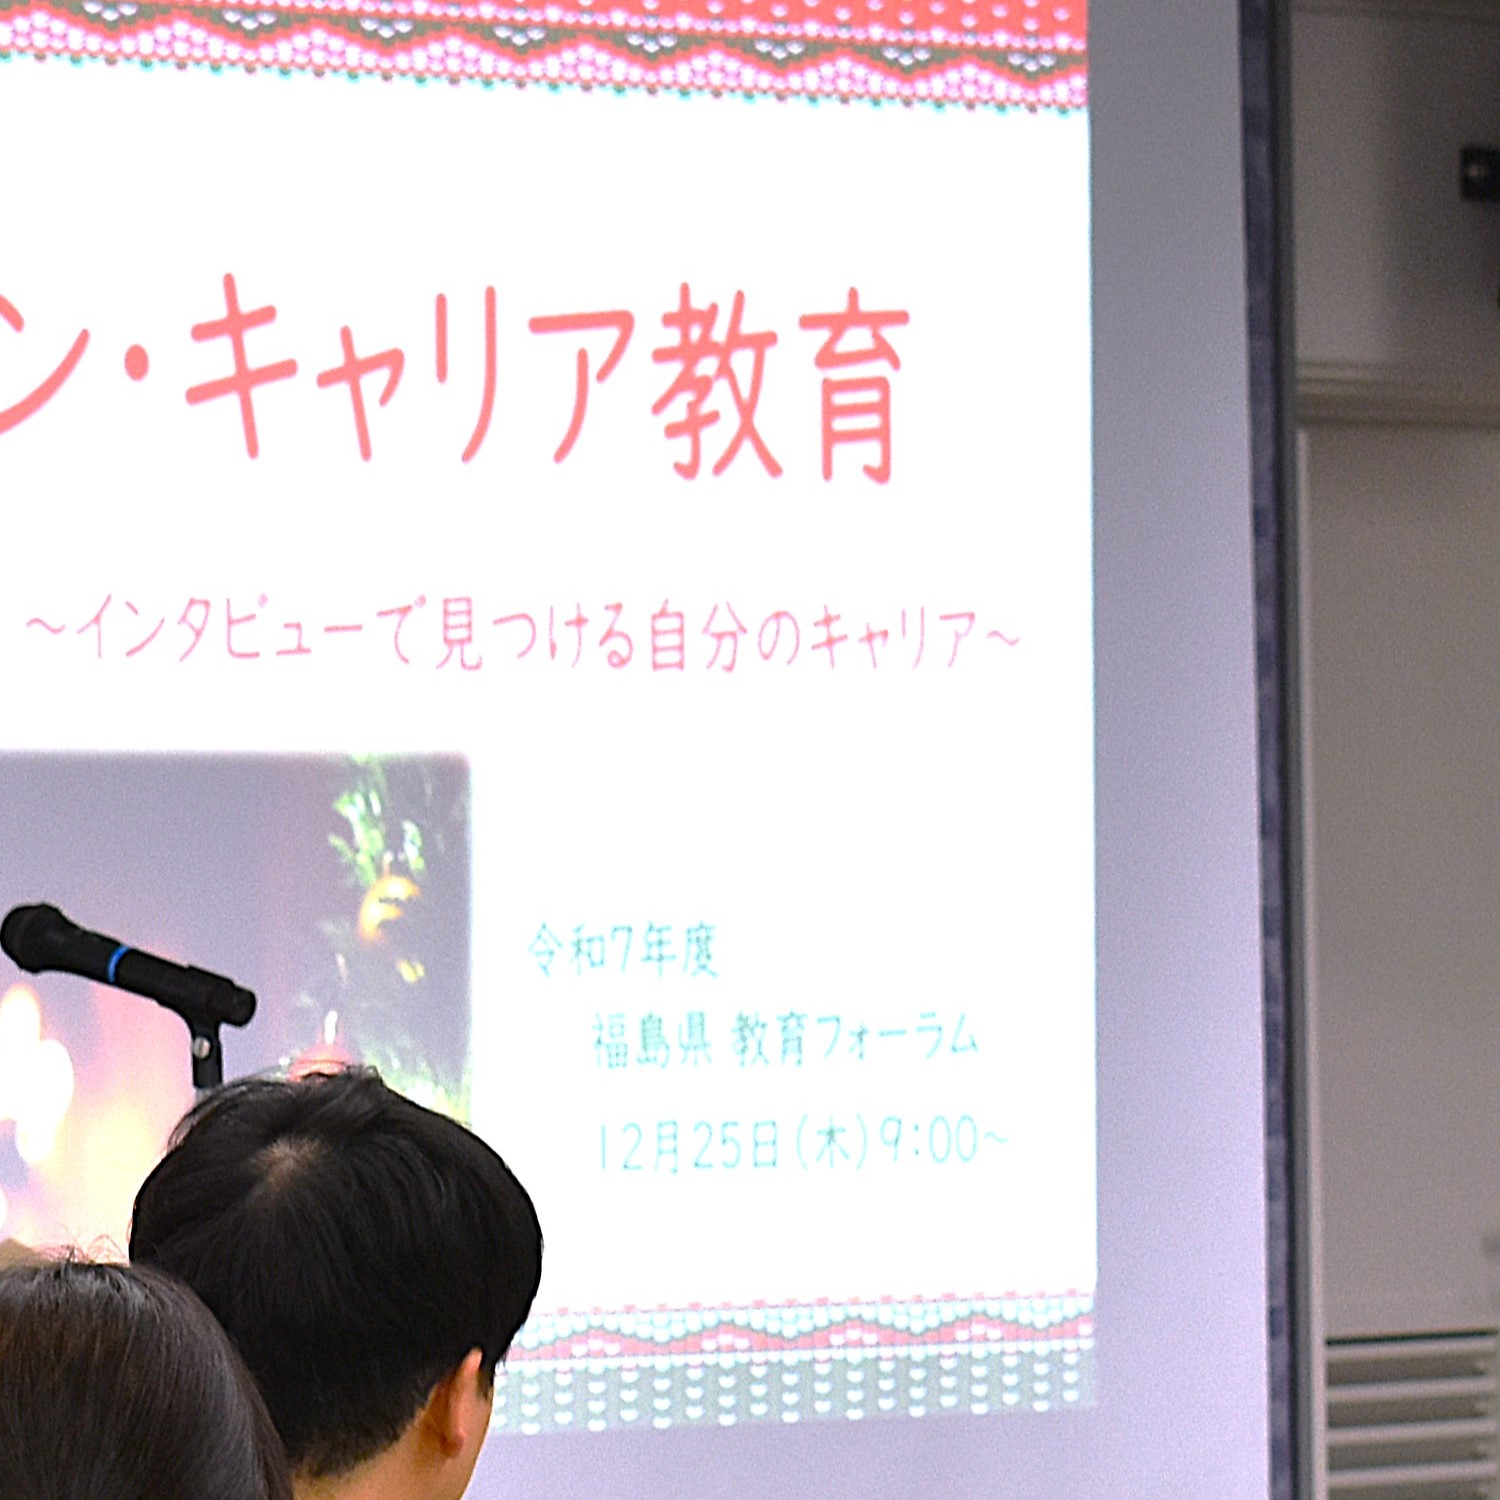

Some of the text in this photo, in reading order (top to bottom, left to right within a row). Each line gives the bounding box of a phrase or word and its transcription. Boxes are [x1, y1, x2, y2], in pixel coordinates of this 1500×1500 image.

[527, 921, 720, 977] 令和7年度
[591, 1010, 981, 1070] 福島県 教育フォーラム
